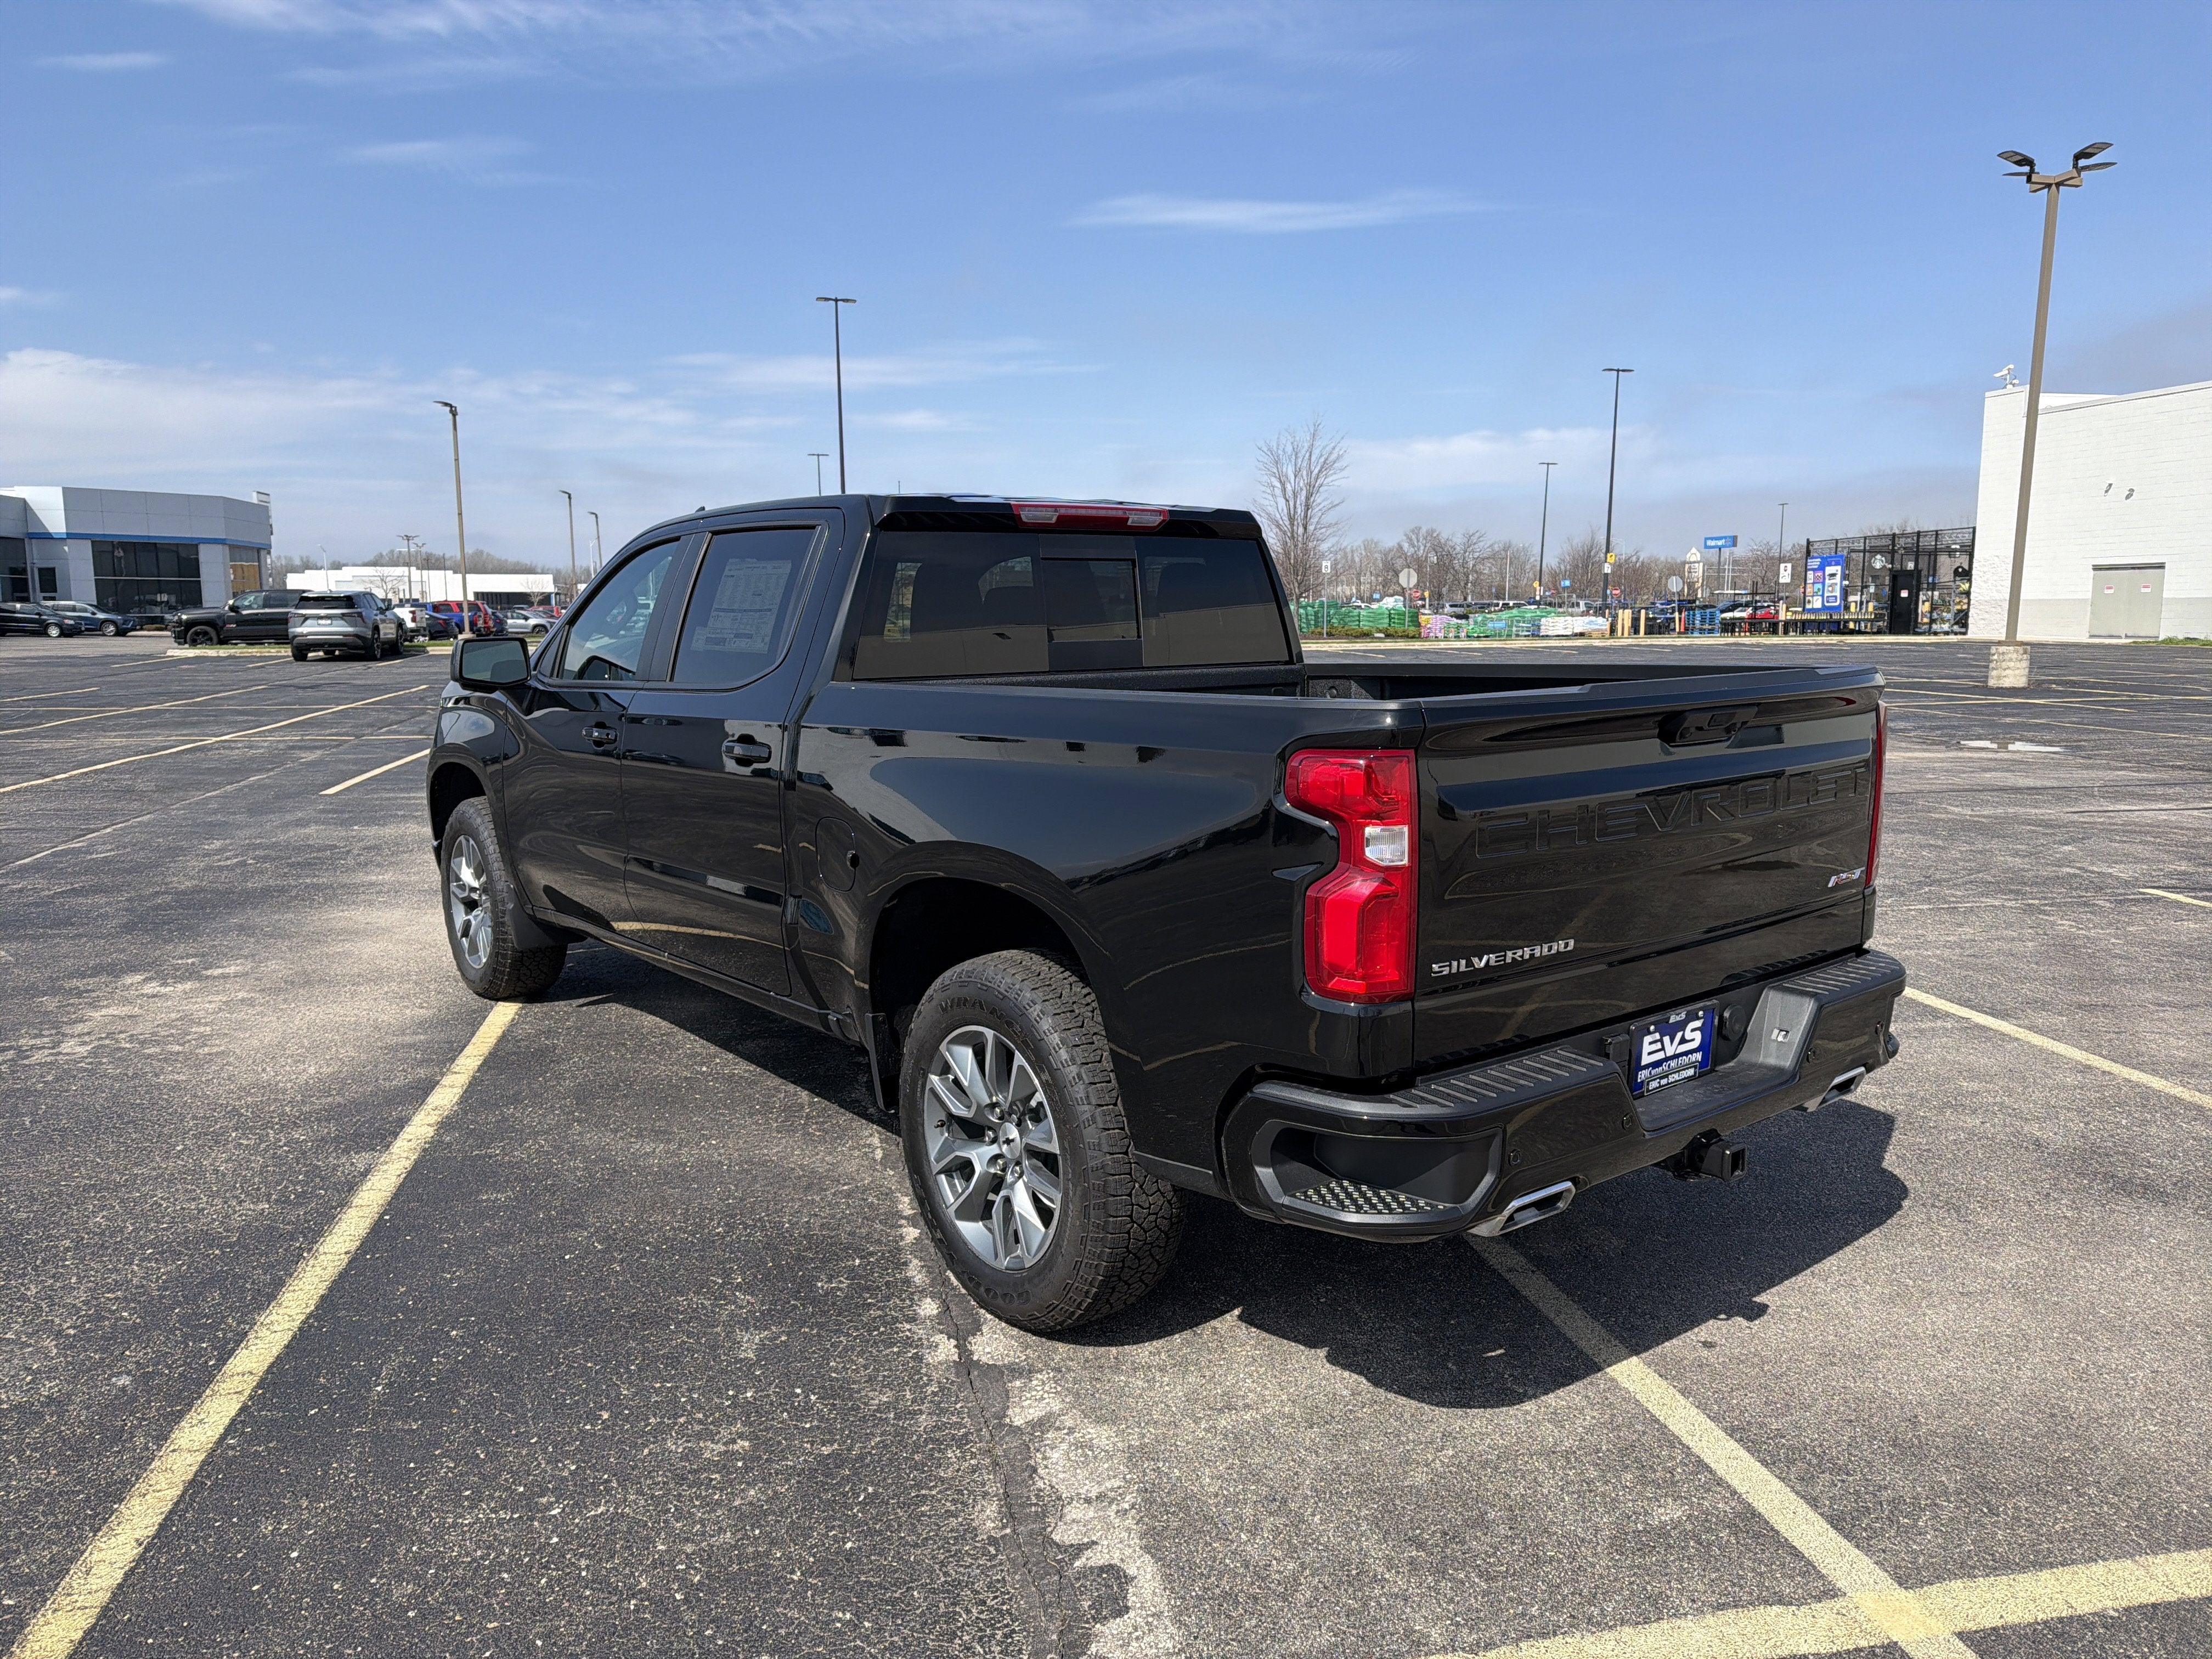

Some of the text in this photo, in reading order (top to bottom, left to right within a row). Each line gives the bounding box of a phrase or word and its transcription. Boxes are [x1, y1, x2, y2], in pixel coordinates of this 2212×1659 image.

[1475, 764, 1866, 859] CHEVROLET
[1431, 939, 1575, 977] SILVERADO
[1649, 1079, 1660, 1090] ERIC
[1668, 1068, 1695, 1083] SCHLEDORN
